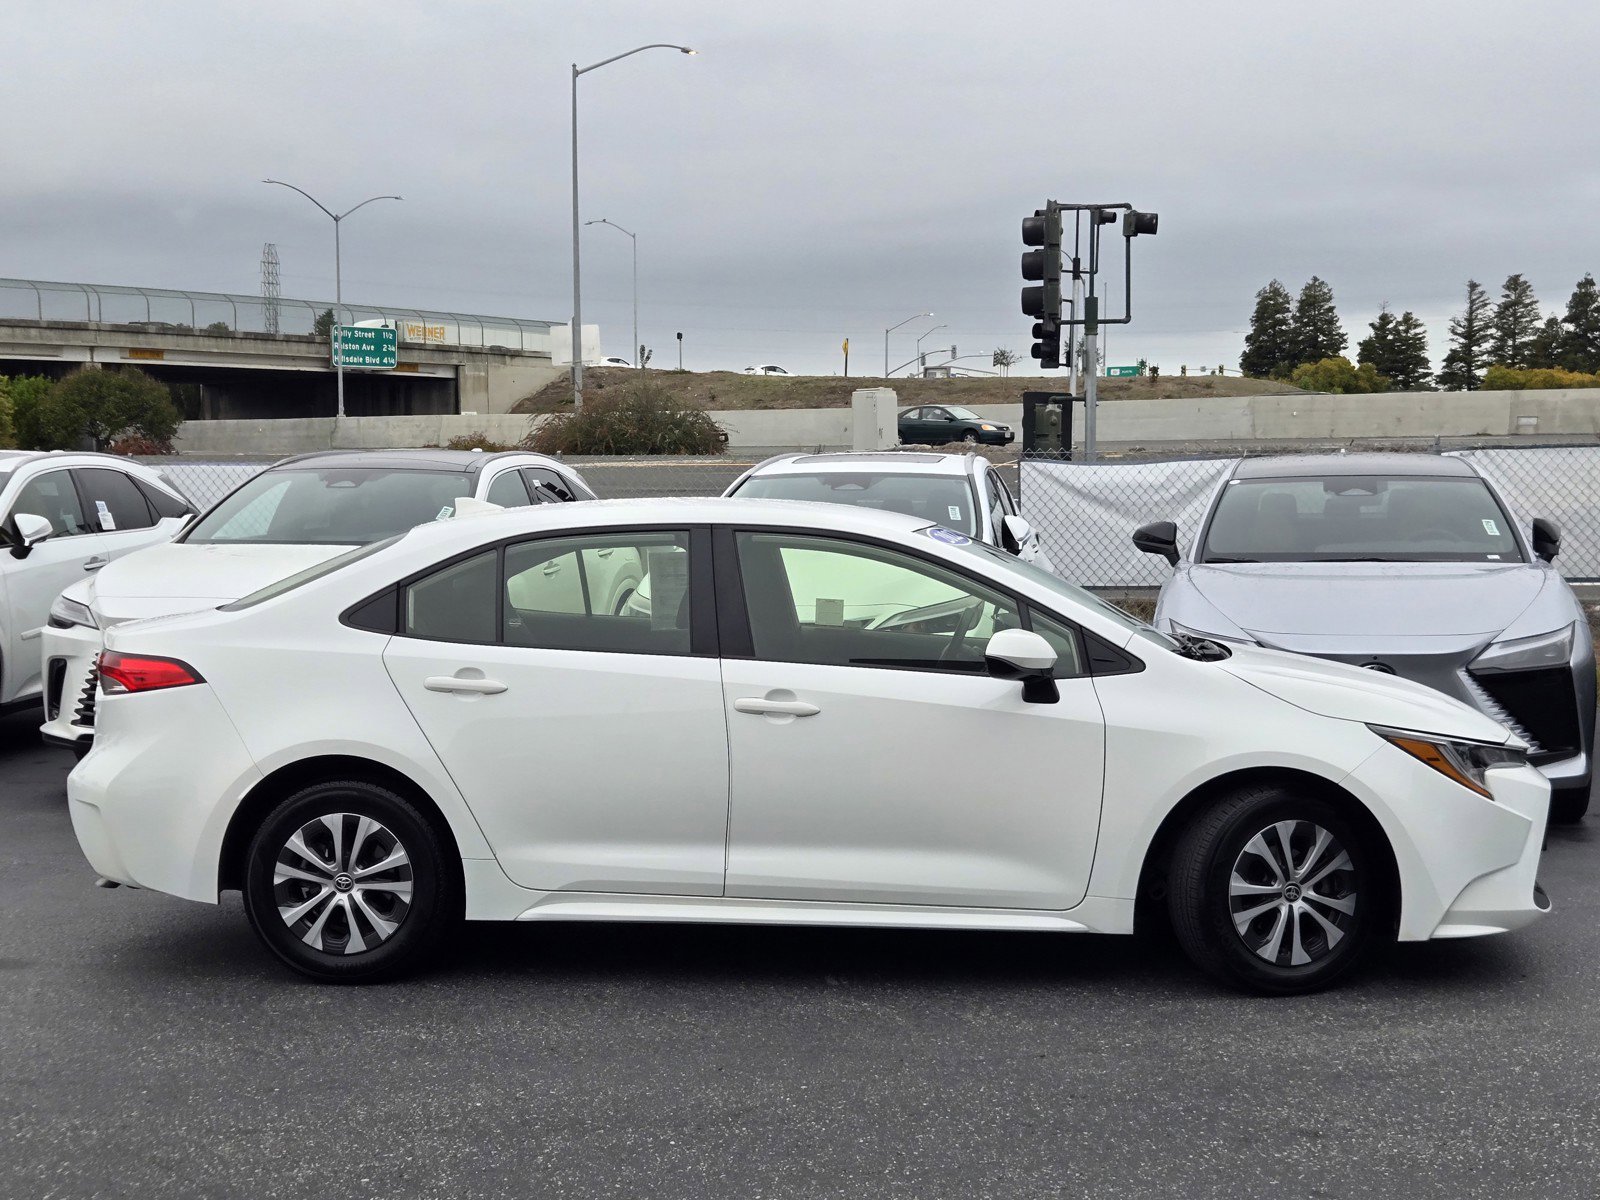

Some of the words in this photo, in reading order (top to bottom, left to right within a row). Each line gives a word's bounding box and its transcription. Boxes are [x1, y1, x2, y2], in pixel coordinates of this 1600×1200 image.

[354, 330, 375, 339] Street
[334, 342, 360, 351] Rlston
[361, 343, 375, 351] Ave
[365, 356, 380, 364] Blvd
